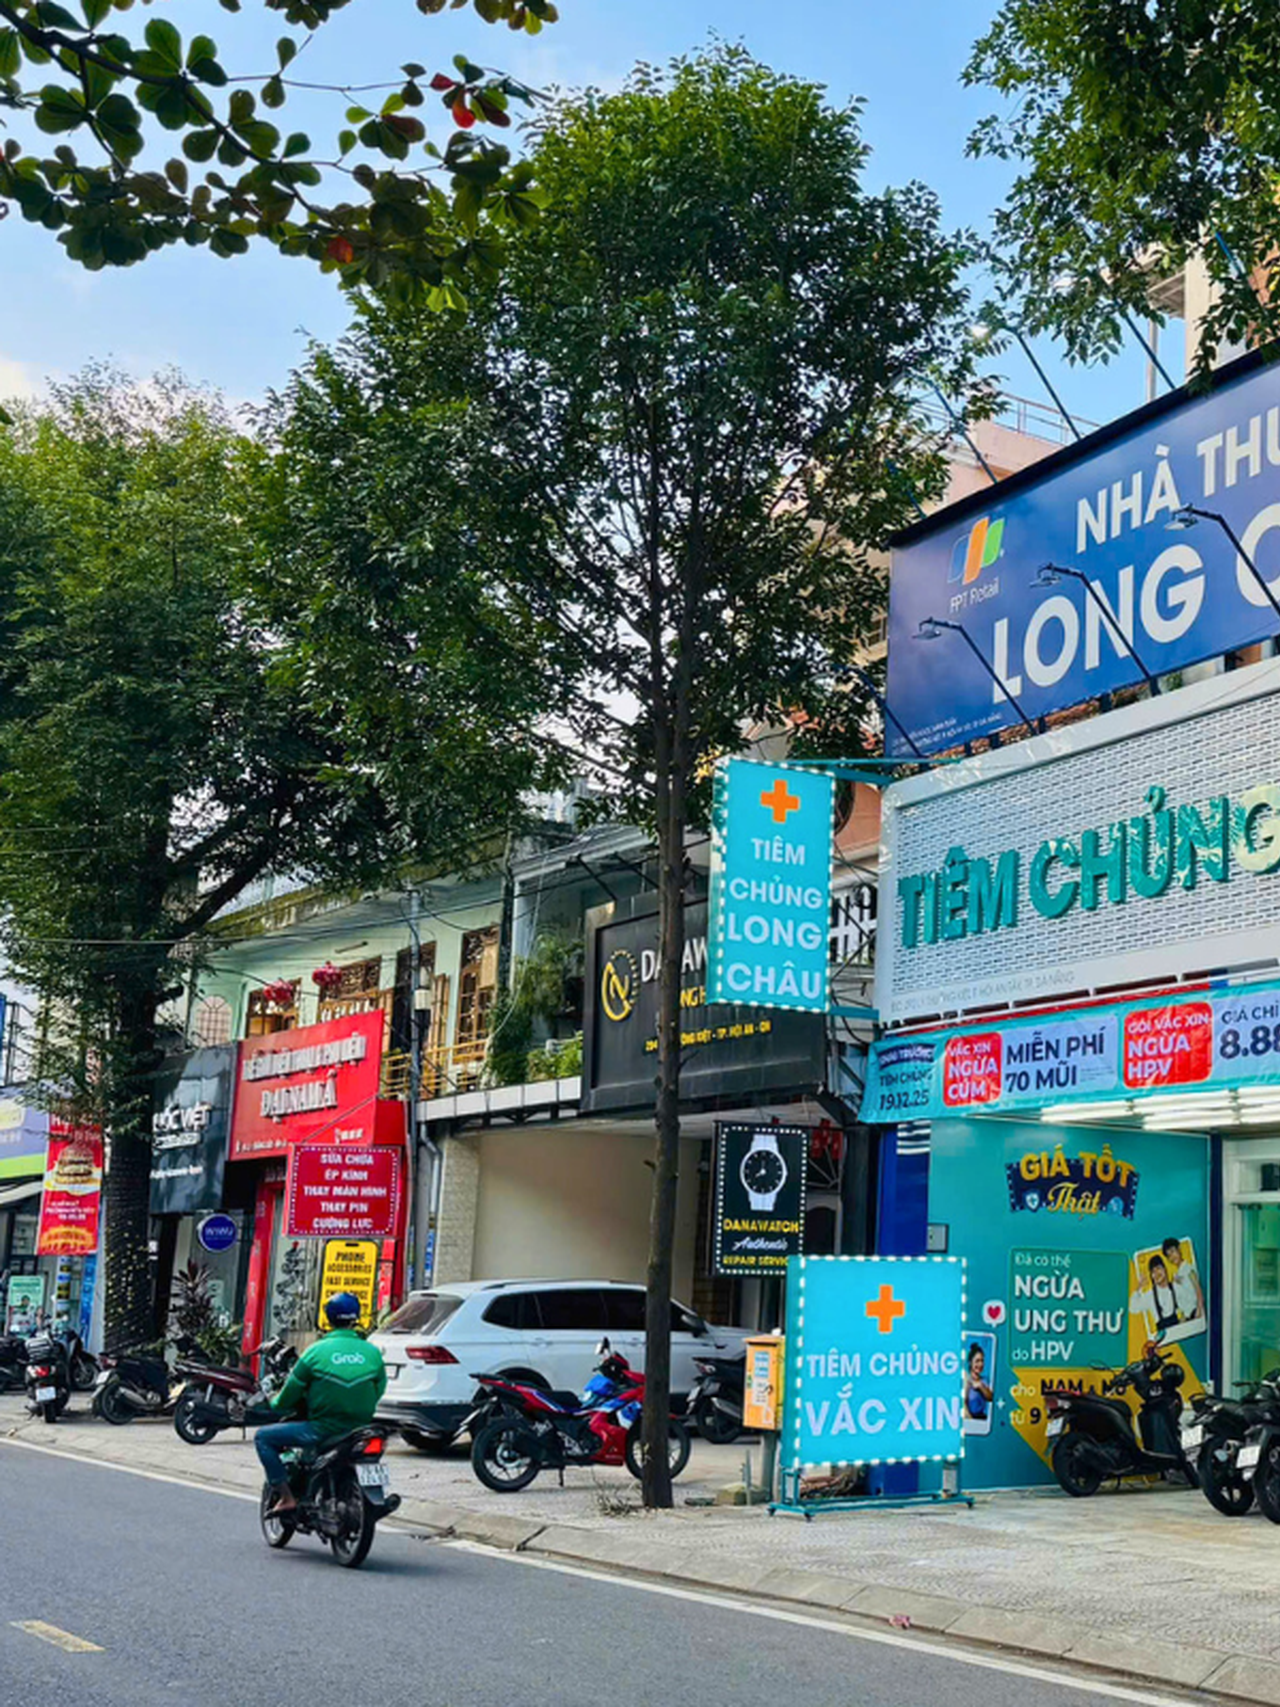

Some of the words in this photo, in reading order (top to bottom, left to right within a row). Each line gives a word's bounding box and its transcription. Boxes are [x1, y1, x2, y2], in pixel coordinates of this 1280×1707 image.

[1076, 444, 1180, 553] NHÀ
[992, 544, 1206, 704] LONG
[751, 835, 805, 865] TIÊM
[729, 874, 823, 909] CHỦNG
[898, 845, 1019, 948] TIÊM
[727, 912, 822, 950] LONG
[726, 960, 821, 999] CHÂU
[1185, 1012, 1209, 1028] XIN
[1221, 1004, 1248, 1024] GIÁ
[1252, 1000, 1279, 1022] CHỈ
[973, 1041, 991, 1054] XIN
[1006, 1032, 1062, 1065] MIỄN
[1067, 1027, 1105, 1056] PHÍ
[1128, 1033, 1191, 1057] NGỪA
[949, 1055, 998, 1079] NGỪA
[1005, 1070, 1032, 1094] 70
[1036, 1061, 1077, 1088] MŨI
[1128, 1059, 1172, 1080] HPV
[1020, 1145, 1070, 1182] GIÁ
[1078, 1144, 1136, 1189] TỐT
[350, 1202, 368, 1213] PIN
[1046, 1181, 1101, 1219] Thật
[723, 1217, 800, 1233] DANAWATCH
[759, 1255, 788, 1267] SERVIC
[1014, 1273, 1085, 1299] NGỪA
[1015, 1312, 1069, 1333] UNG
[1073, 1308, 1124, 1333] THƯ
[331, 1352, 366, 1364] Grab
[806, 1348, 861, 1378] TIÊM
[868, 1344, 959, 1376] CHỦNG
[1012, 1347, 1028, 1361] do
[1030, 1341, 1074, 1361] HPV
[1010, 1381, 1036, 1397] cho
[805, 1383, 887, 1437] VẮC
[898, 1397, 960, 1432] XIN
[1030, 1407, 1042, 1424] 9
